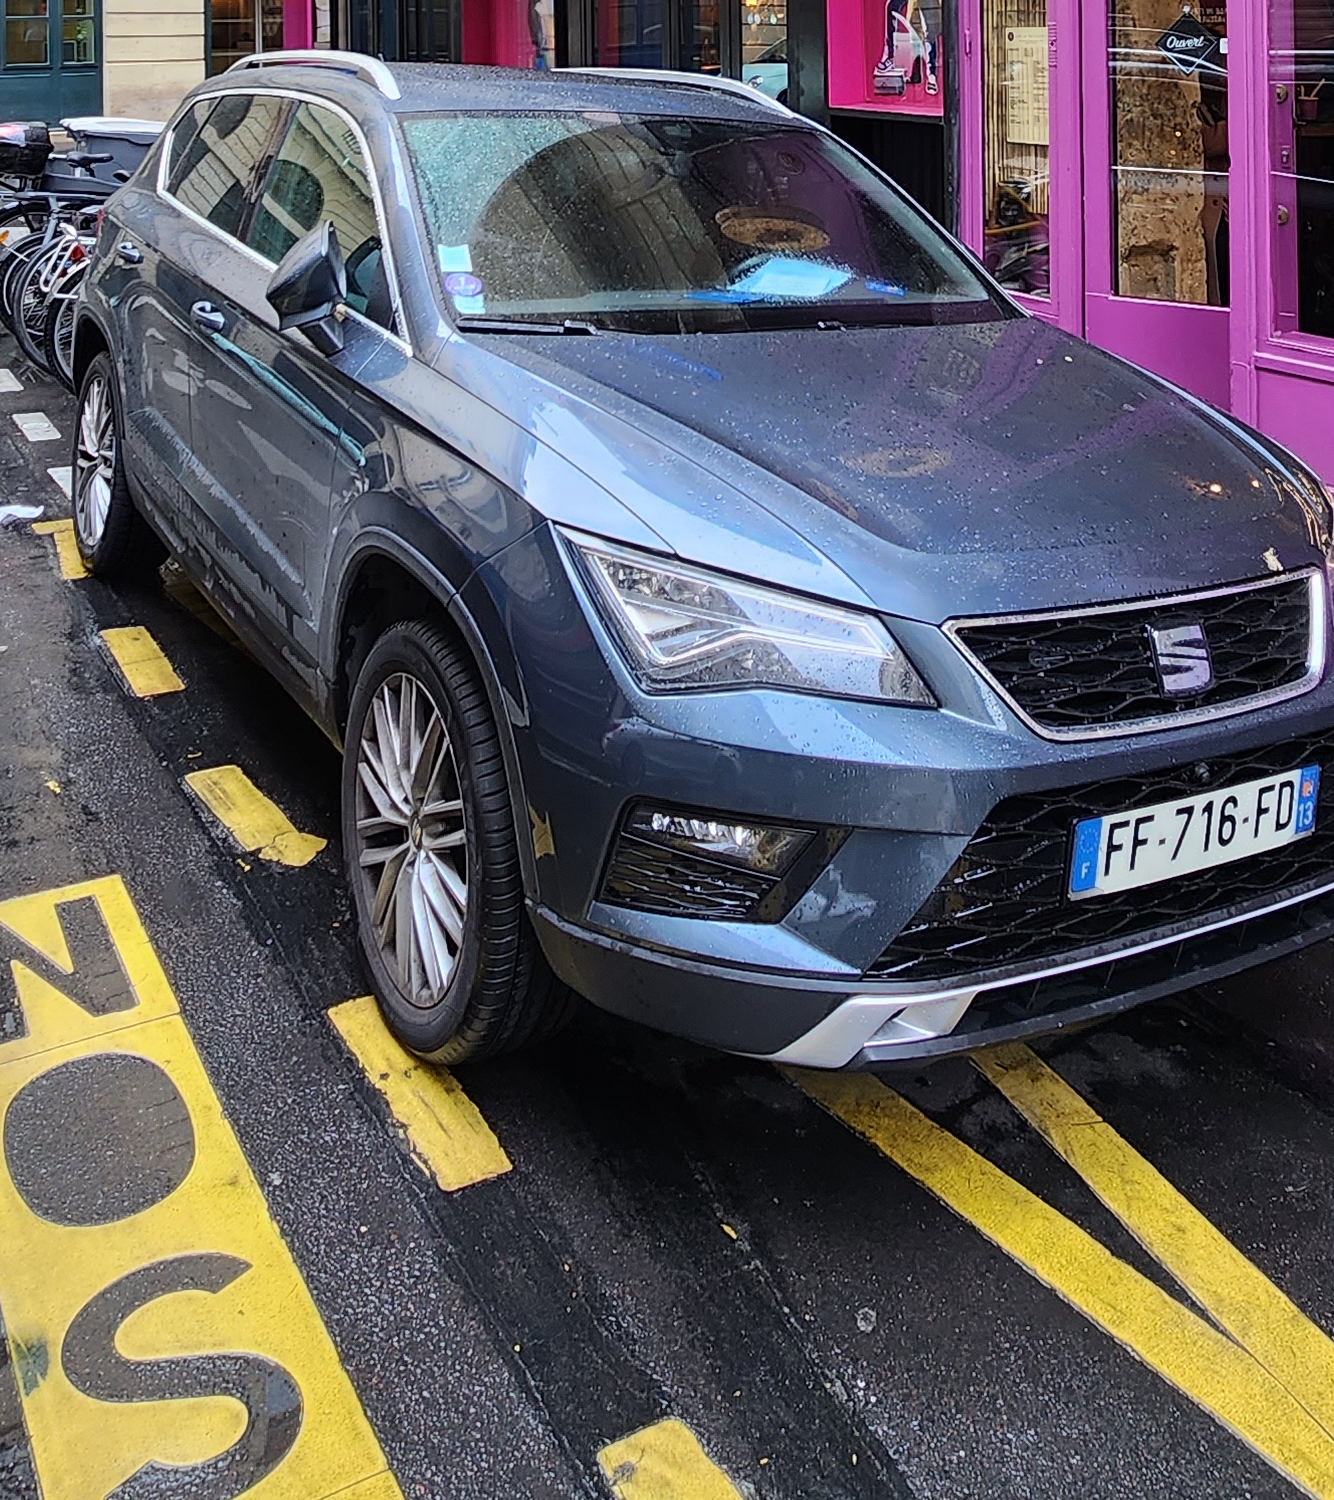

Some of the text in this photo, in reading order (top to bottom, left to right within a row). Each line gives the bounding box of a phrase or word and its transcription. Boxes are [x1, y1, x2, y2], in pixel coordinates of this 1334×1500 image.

[1166, 36, 1207, 51] Ouvert
[1081, 779, 1314, 880] F FF-716-FD 13
